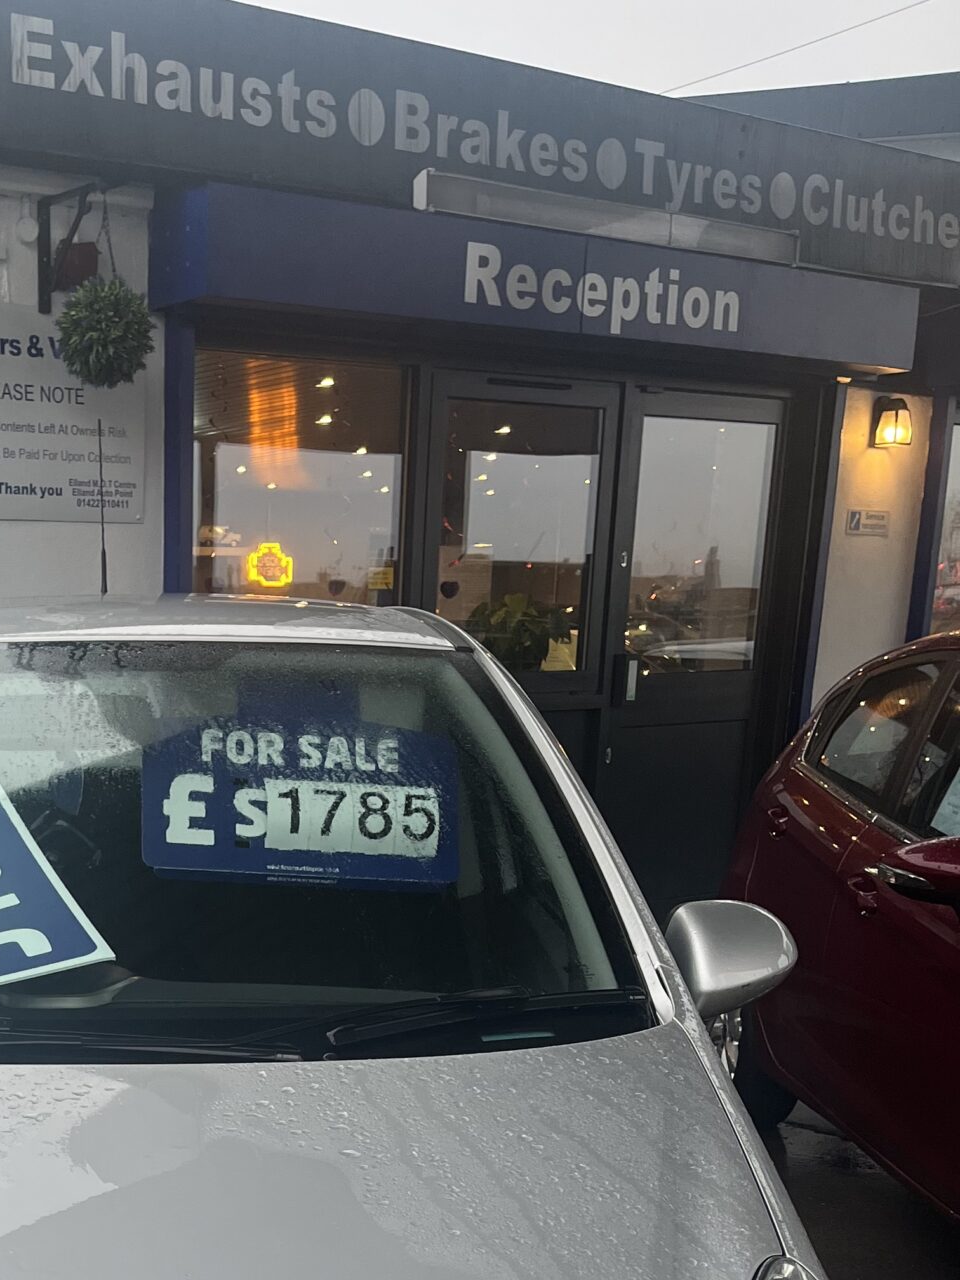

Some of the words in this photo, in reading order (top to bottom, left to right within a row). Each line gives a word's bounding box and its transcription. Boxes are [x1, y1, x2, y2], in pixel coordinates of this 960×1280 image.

[10, 9, 338, 139] Exhausts
[394, 89, 589, 183] Brakes
[634, 138, 764, 214] Tyres
[463, 241, 741, 335] Reception
[26, 335, 44, 358] &
[39, 385, 85, 405] NOTE
[38, 422, 56, 435] Left
[57, 423, 69, 435] At
[70, 424, 106, 438] Ownes
[107, 426, 128, 439] Risk
[2, 447, 17, 459] Be
[18, 448, 40, 460] Paid
[42, 449, 59, 461] For
[60, 450, 86, 464] Upon
[87, 451, 132, 465] Colection
[40, 486, 63, 499] you
[201, 728, 286, 767] FOR
[298, 734, 399, 773] SALE
